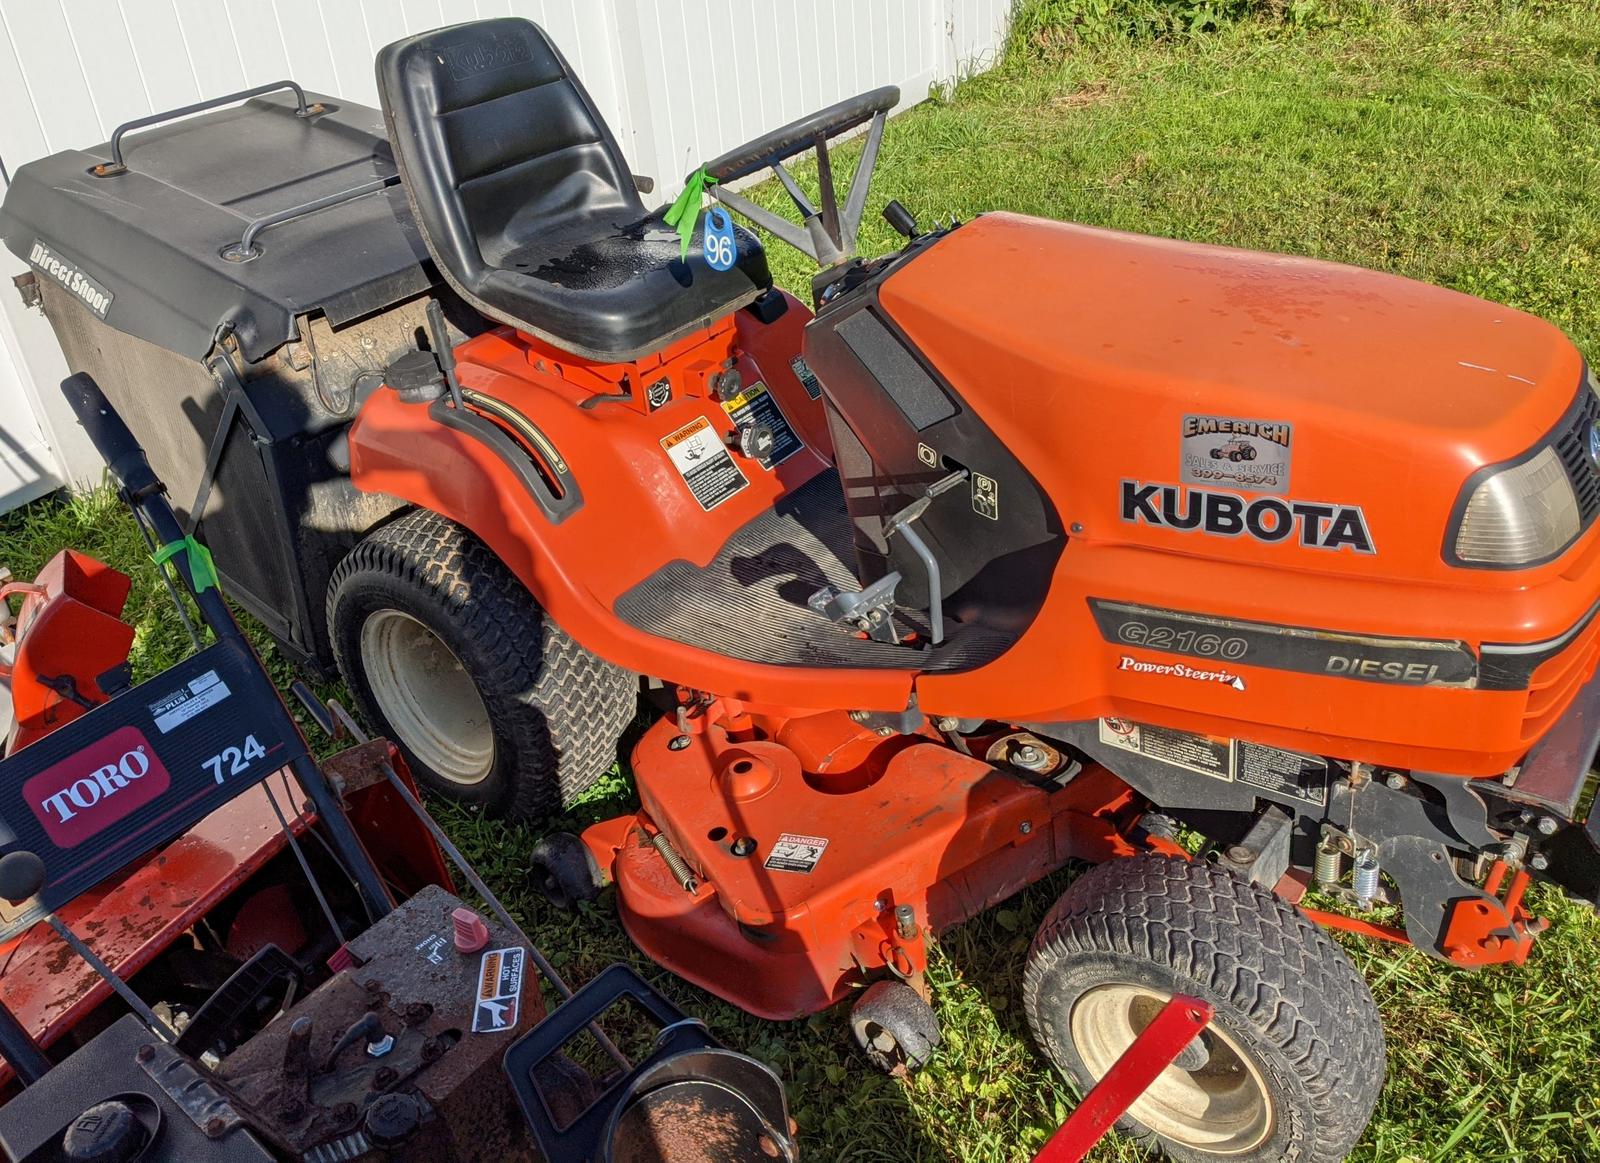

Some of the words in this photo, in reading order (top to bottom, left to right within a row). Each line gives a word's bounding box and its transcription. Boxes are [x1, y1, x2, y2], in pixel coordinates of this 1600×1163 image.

[706, 234, 732, 265] 96
[673, 421, 704, 443] WARNING
[1183, 416, 1290, 448] EMERICH
[1184, 452, 1218, 469] SALES
[1223, 462, 1233, 471] &
[1238, 462, 1285, 476] SERVICE
[1121, 479, 1376, 554] KUBOTA
[1118, 621, 1249, 660] G2160
[1324, 655, 1440, 683] DIESEL
[201, 734, 266, 785] 724
[41, 749, 149, 824] TORO
[788, 836, 826, 846] DANGER
[414, 934, 437, 951] CHOKE
[484, 953, 497, 988] WARNING
[502, 965, 510, 981] HOT
[509, 953, 521, 992] SURFACES
